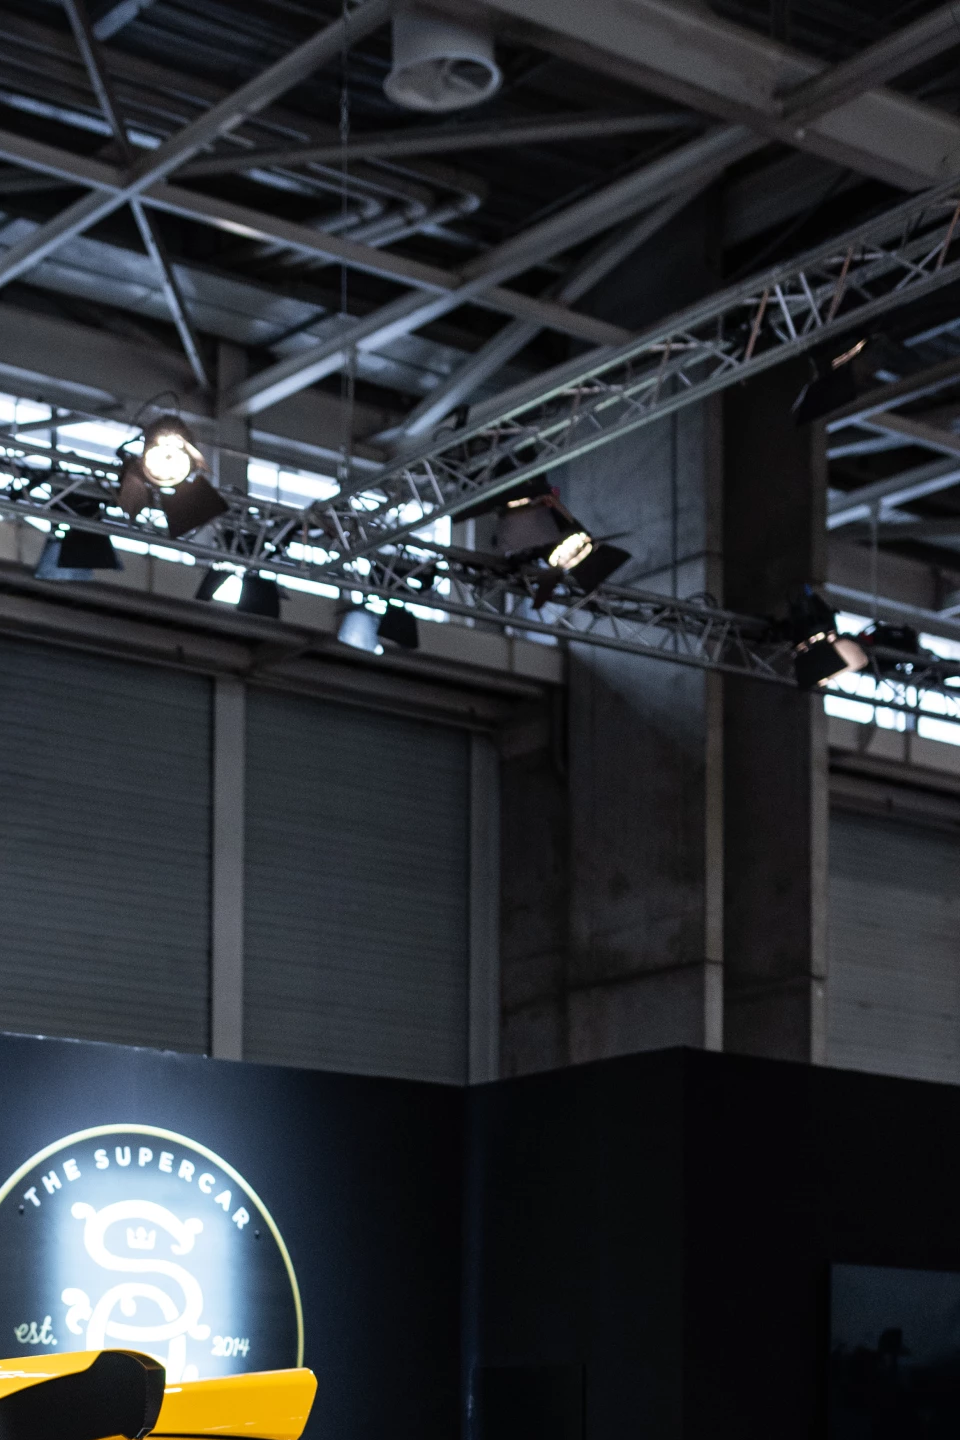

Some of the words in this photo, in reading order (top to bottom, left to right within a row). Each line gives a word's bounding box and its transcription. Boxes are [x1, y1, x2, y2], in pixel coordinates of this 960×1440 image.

[23, 1158, 82, 1207] THE
[94, 1146, 251, 1230] SUPERCAR
[13, 1315, 58, 1346] est.
[211, 1335, 250, 1358] 2014
